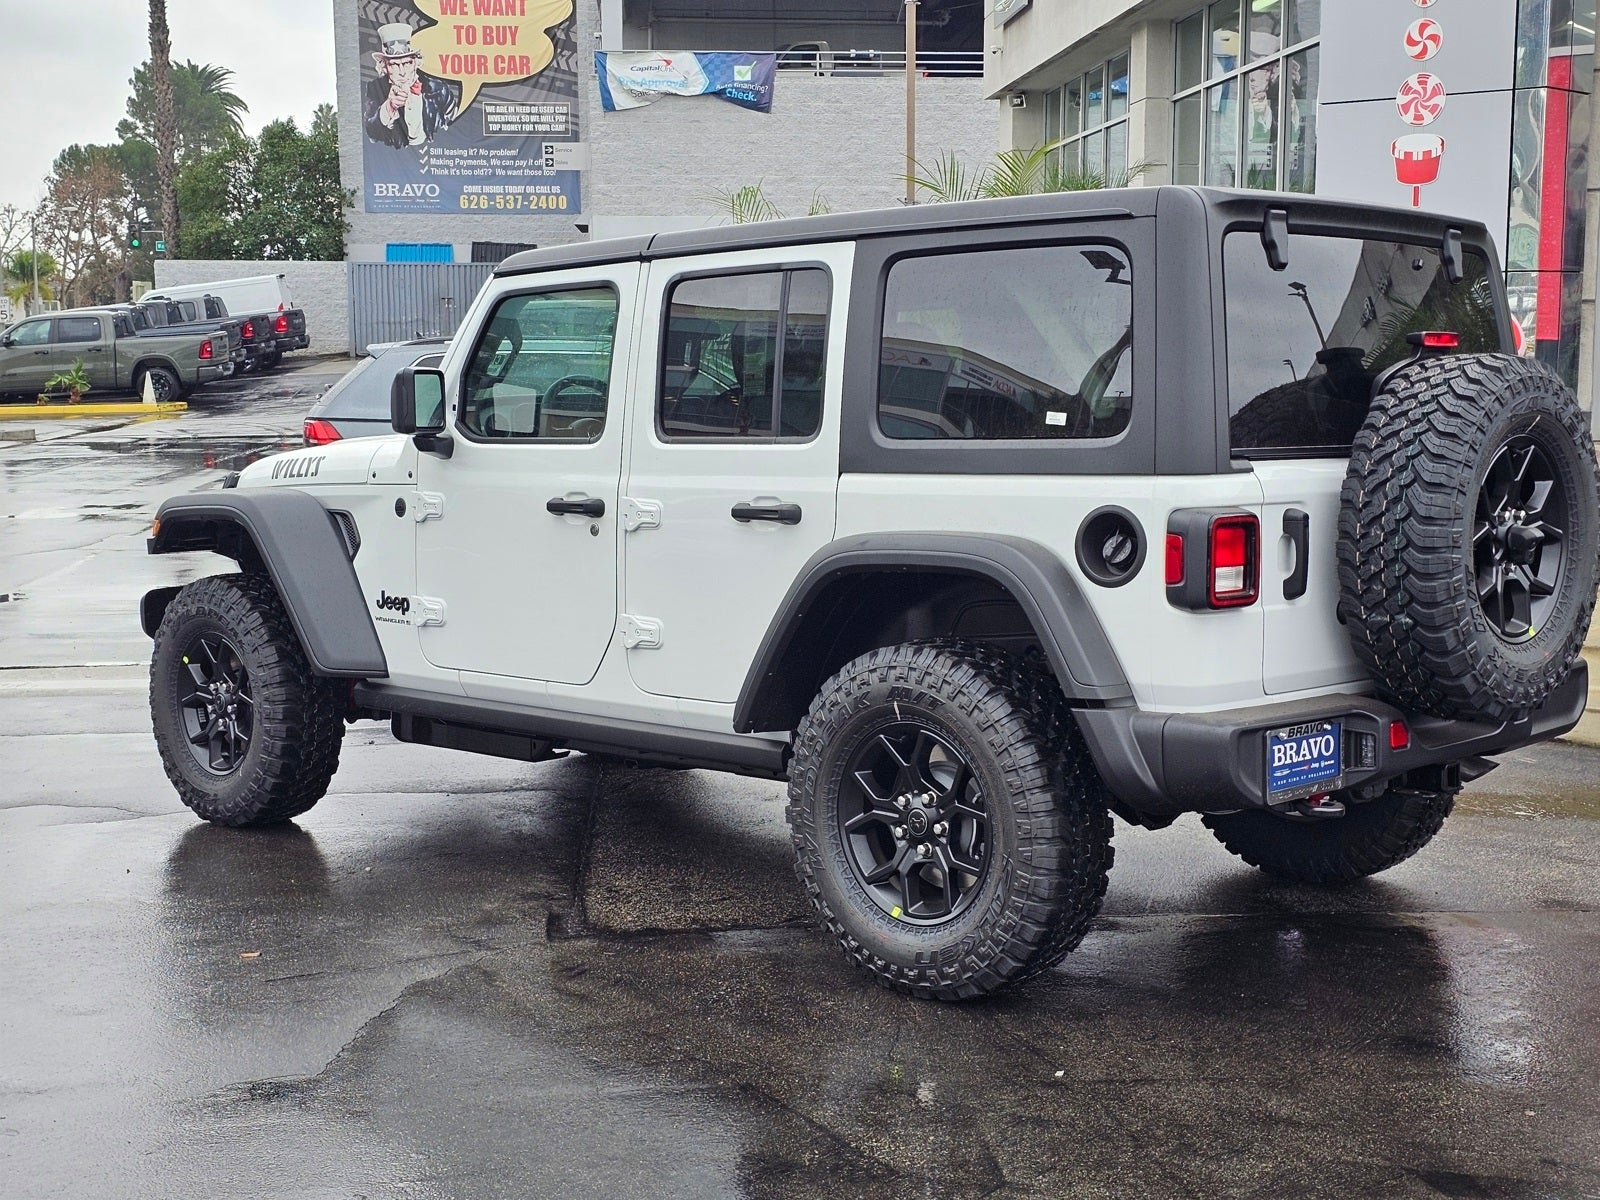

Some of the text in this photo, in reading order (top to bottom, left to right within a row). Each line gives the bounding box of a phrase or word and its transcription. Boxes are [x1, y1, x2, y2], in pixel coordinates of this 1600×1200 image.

[439, 0, 526, 16] WE WANT
[453, 25, 519, 46] TO BUY
[439, 54, 531, 75] YOUR CAR
[734, 82, 769, 93] financing?
[726, 88, 757, 102] Check.
[534, 124, 550, 132] YOUR
[429, 148, 443, 156] Still
[443, 148, 468, 157] leasing
[468, 148, 478, 156] it?
[489, 149, 519, 158] problem!
[430, 158, 454, 167] Making
[455, 159, 489, 168] Payments,
[514, 160, 527, 168] pay
[430, 167, 449, 175] Think
[373, 183, 440, 197] BRAVO
[463, 185, 561, 193] COME INSIDE TODAY OR CALL US
[459, 195, 567, 209] 626-537-2400
[271, 456, 327, 480] WILLYS
[376, 590, 410, 616] Jeep
[375, 616, 405, 625] WRANGLER
[1287, 721, 1324, 738] BRAVO
[1272, 734, 1335, 767] BRAVO
